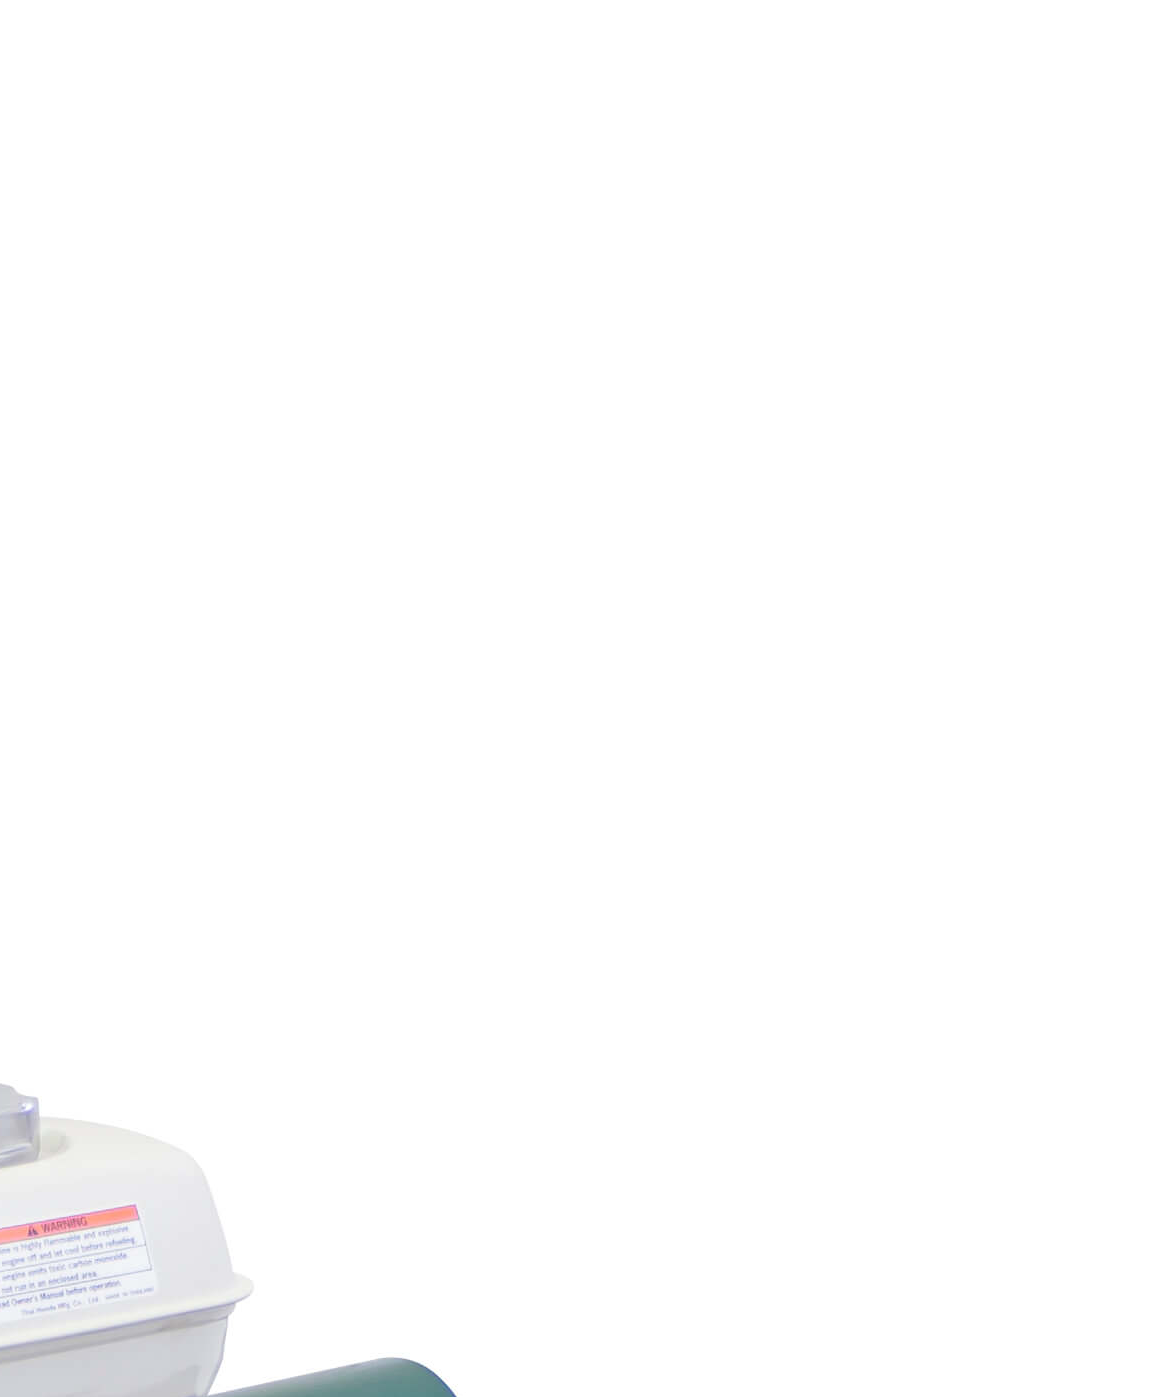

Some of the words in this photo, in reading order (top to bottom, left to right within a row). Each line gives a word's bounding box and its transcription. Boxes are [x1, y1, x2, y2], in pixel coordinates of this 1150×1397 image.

[41, 1216, 88, 1233] WARNING
[20, 1241, 42, 1255] highly
[83, 1231, 96, 1241] and
[1, 1257, 25, 1268] engine
[39, 1251, 52, 1260] and
[81, 1242, 104, 1254] before
[1, 1271, 26, 1283] engine
[40, 1289, 65, 1300] Manual
[66, 1285, 88, 1296] before
